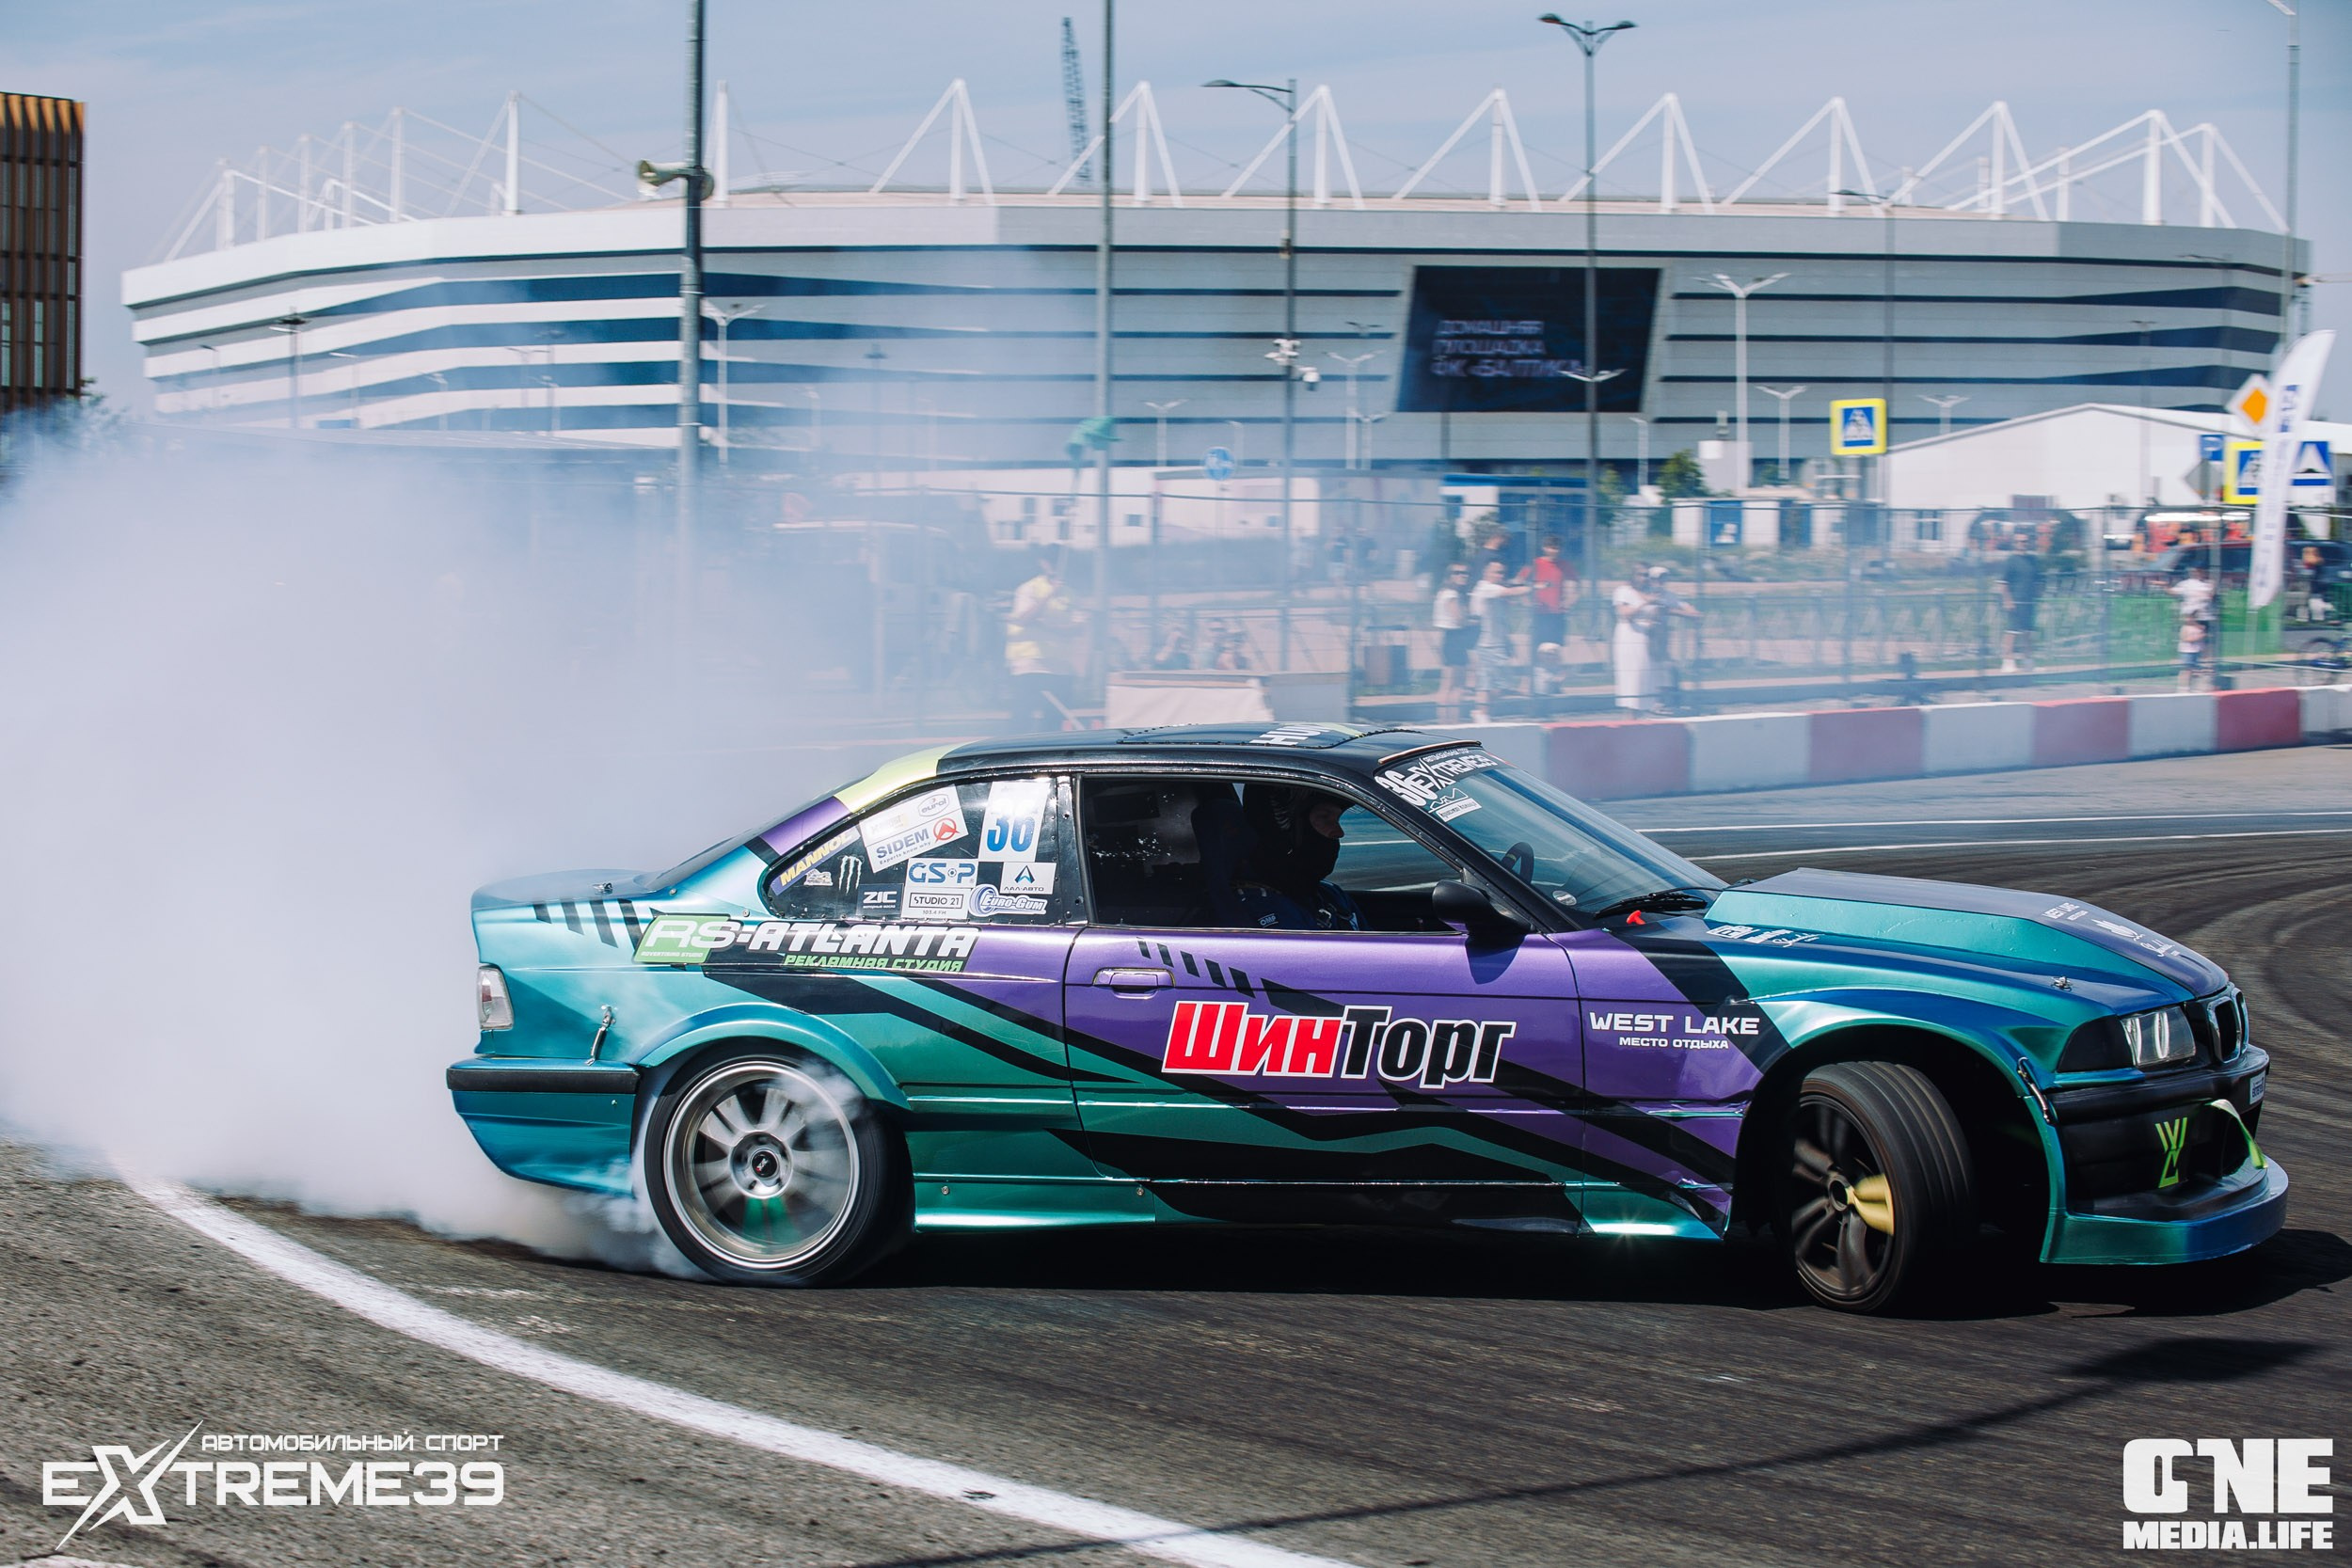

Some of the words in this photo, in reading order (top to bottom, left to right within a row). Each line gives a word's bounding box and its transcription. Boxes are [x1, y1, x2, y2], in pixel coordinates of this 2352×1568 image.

[921, 798, 947, 814] eurol
[876, 829, 930, 859] SIDEM
[780, 832, 853, 886] MANNOL
[863, 891, 897, 904] ZIC
[914, 895, 947, 905] STUDIO
[950, 897, 960, 906] 21
[1260, 915, 1277, 926] OMP
[784, 955, 887, 969] РЕКЛАМНАЯ
[891, 958, 964, 973] СТУДИЯ
[1589, 1012, 1674, 1033] WEST
[1684, 1016, 1760, 1035] LAKE
[1619, 1037, 1668, 1047] МЕСТО
[1673, 1038, 1729, 1049] ОТДЫХА
